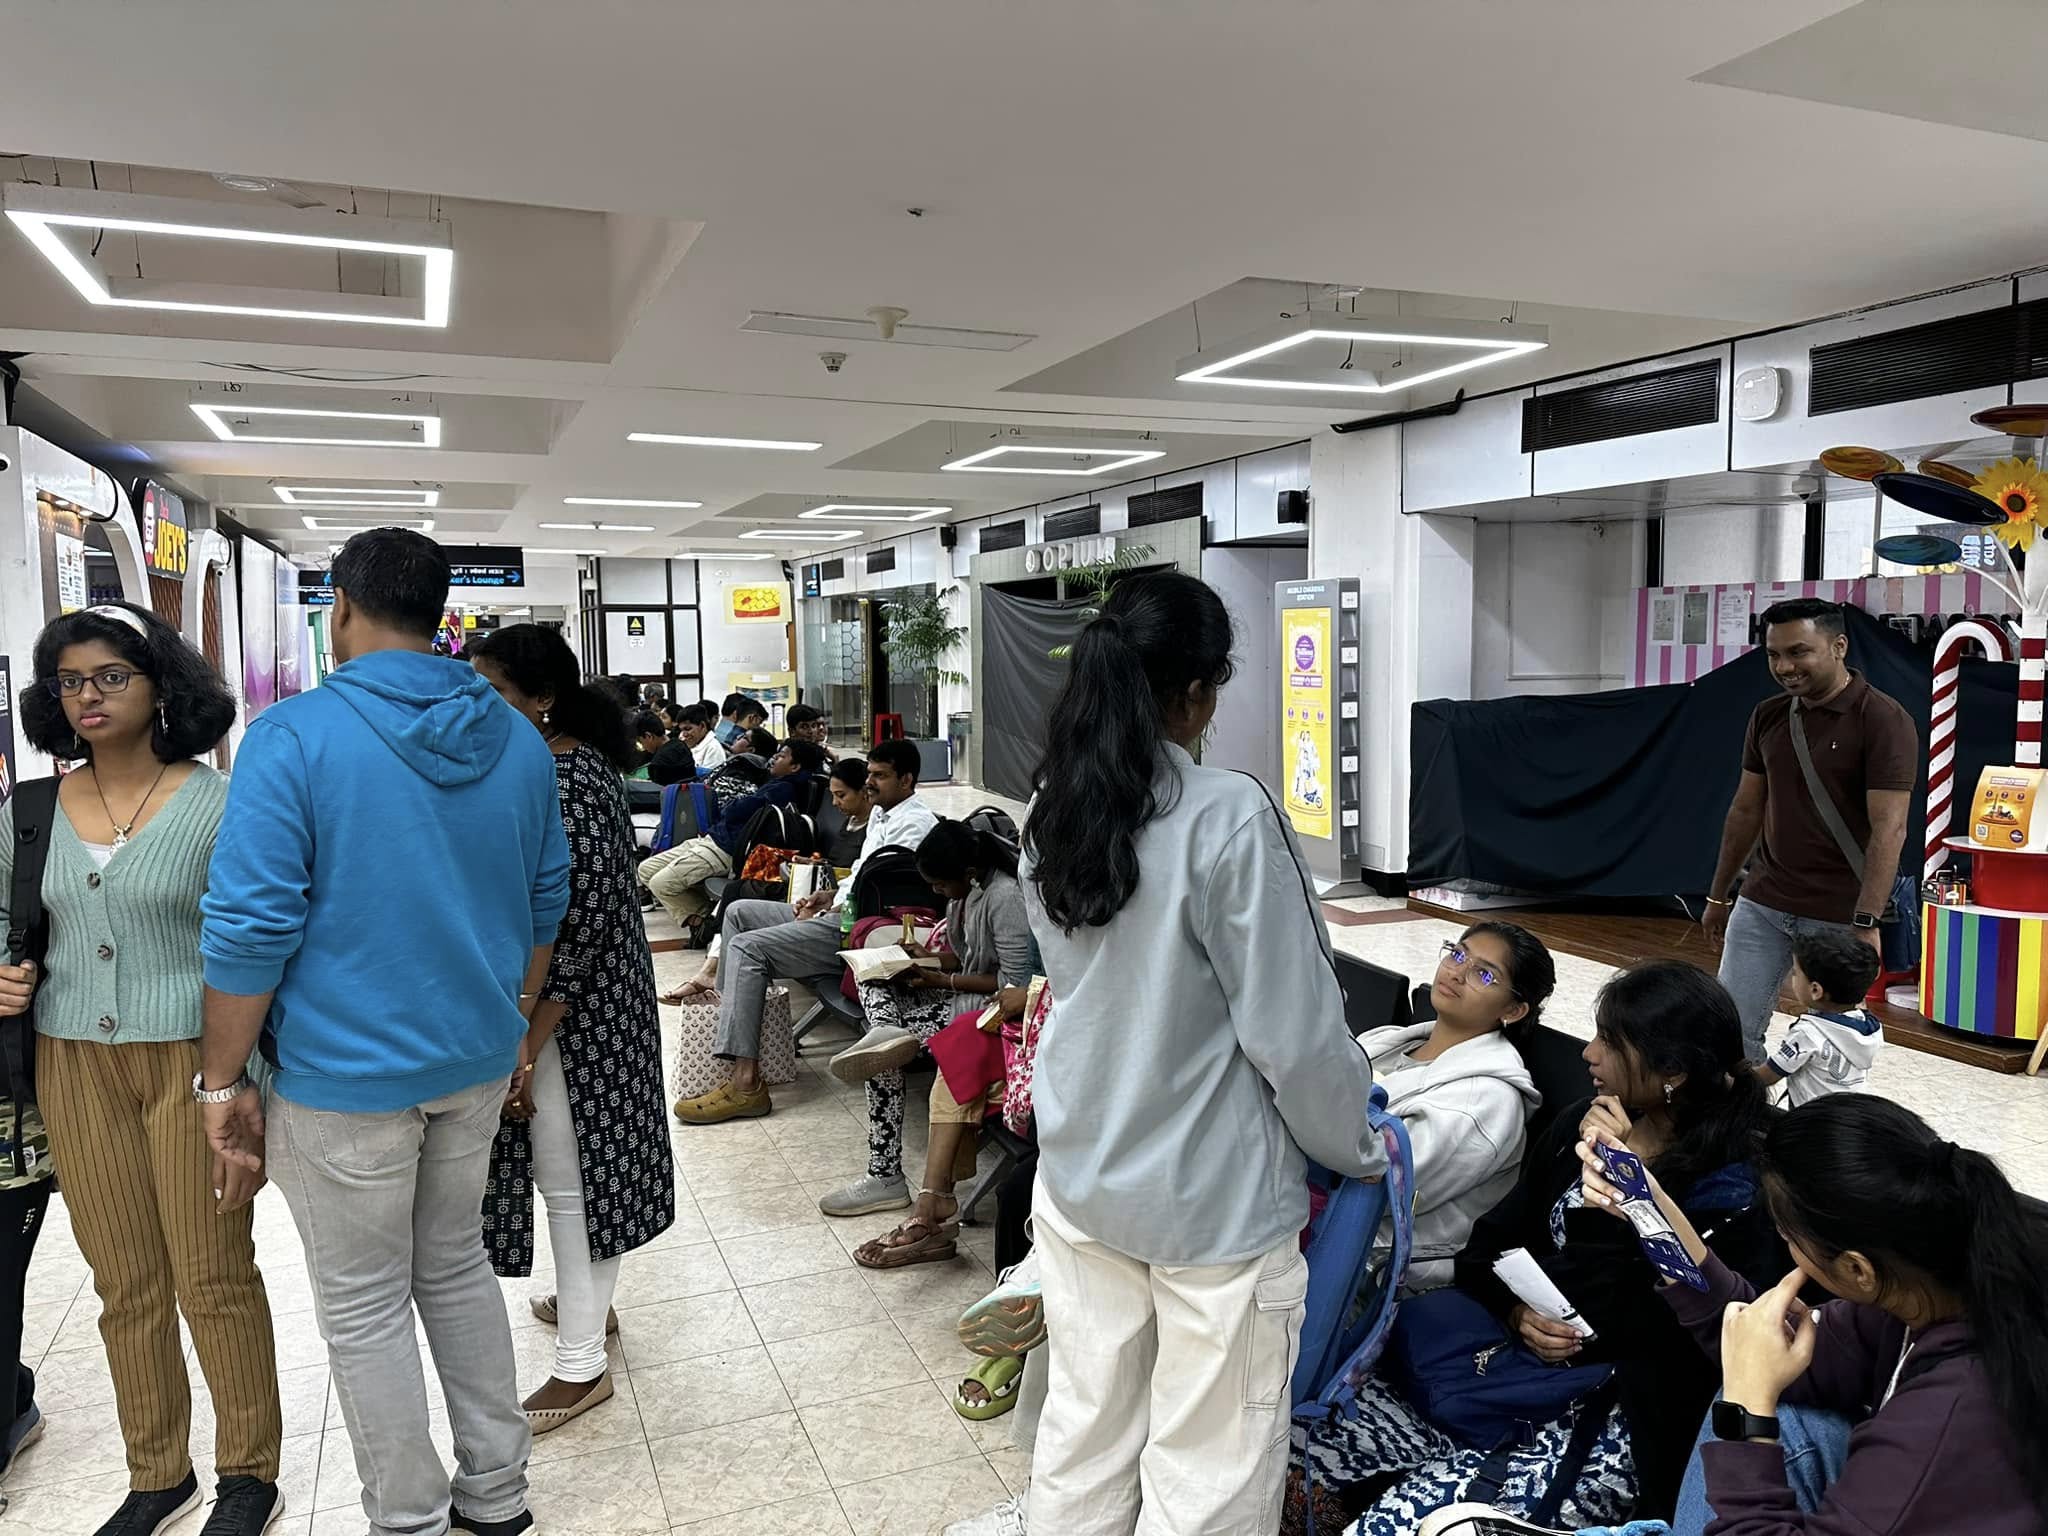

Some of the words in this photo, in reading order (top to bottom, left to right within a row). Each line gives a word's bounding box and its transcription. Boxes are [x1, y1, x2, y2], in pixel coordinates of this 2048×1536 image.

[154, 518, 186, 574] JOEY'S
[1042, 536, 1116, 571] OPIUM
[472, 576, 505, 585] Lounge
